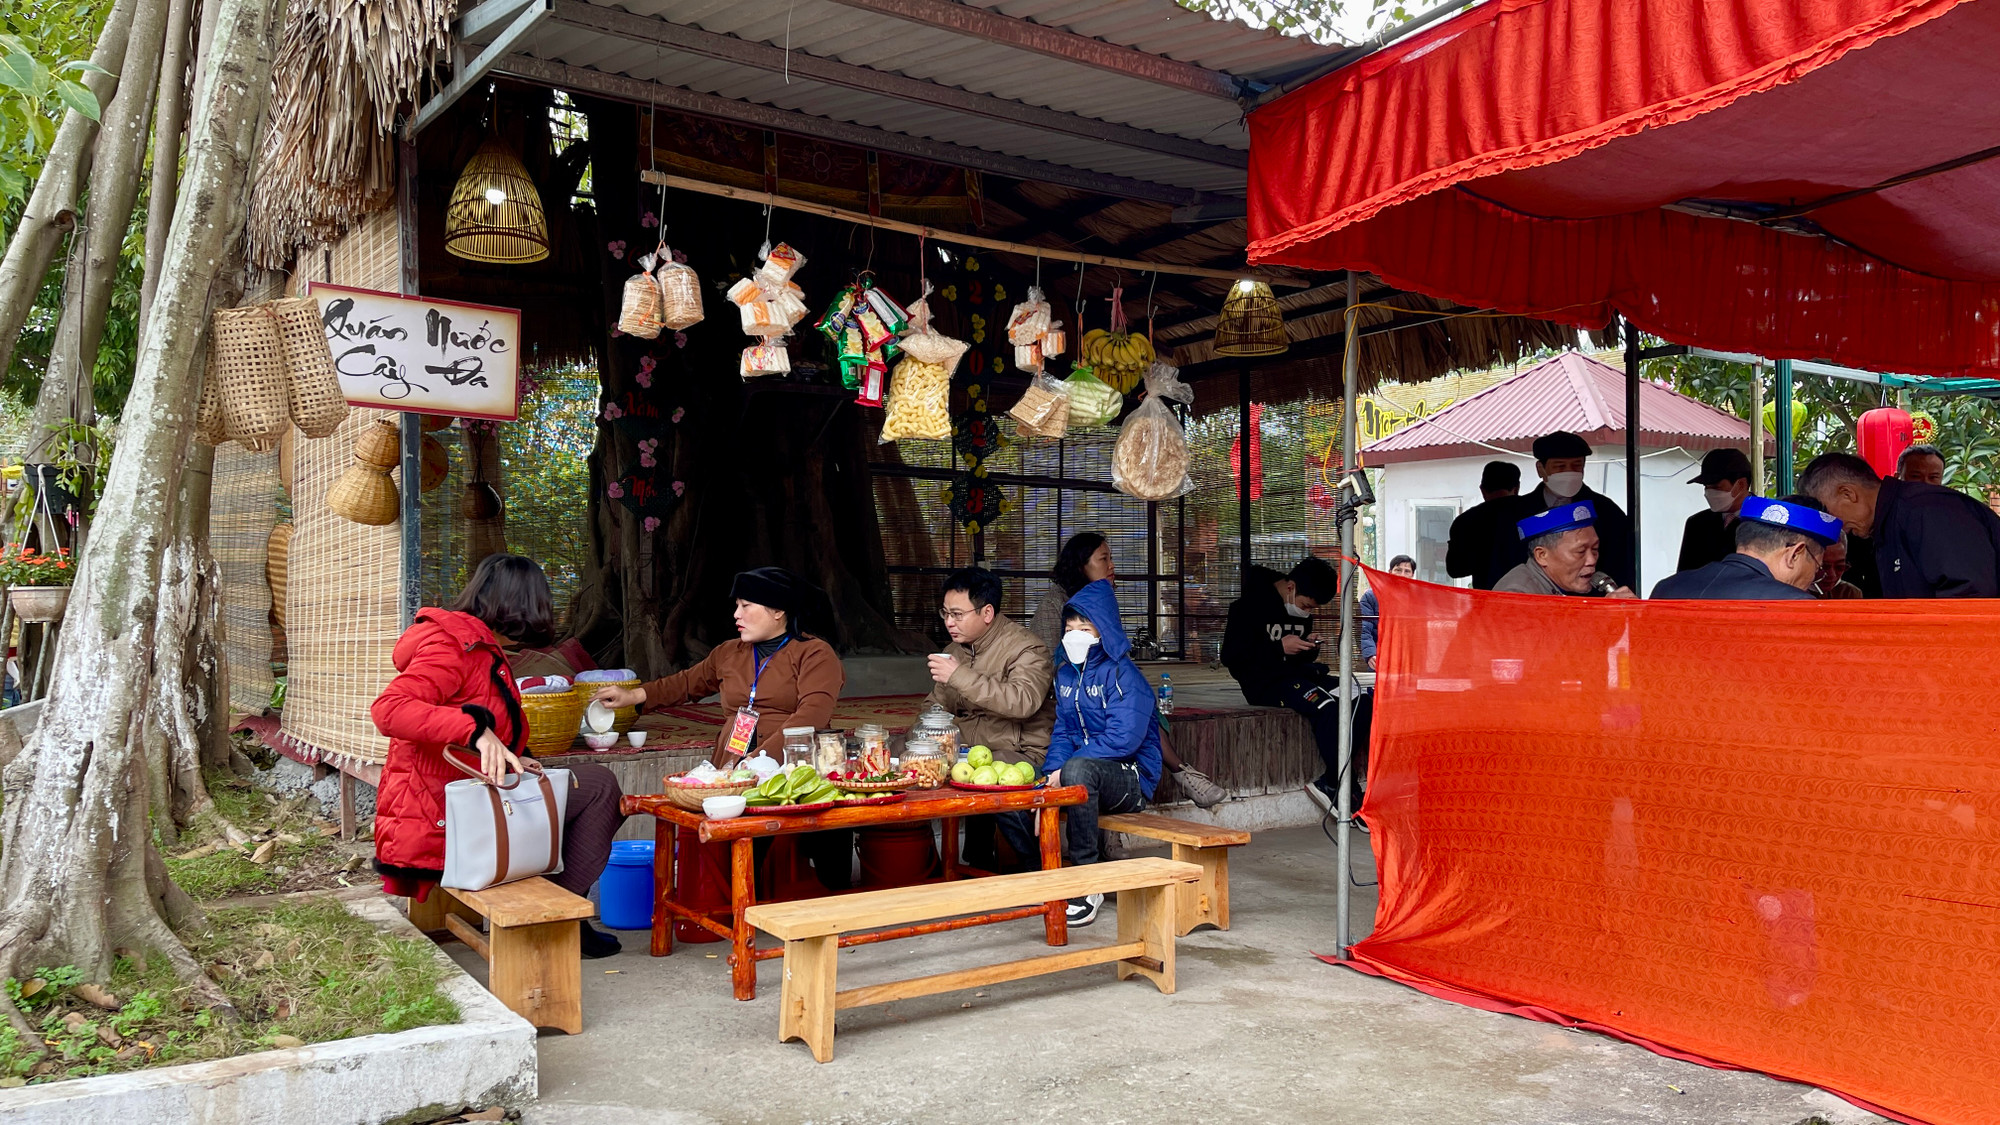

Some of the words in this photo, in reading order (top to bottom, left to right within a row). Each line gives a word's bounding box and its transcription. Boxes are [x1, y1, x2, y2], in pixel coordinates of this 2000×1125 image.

[322, 297, 408, 343] Quán
[425, 308, 511, 360] Nước
[335, 343, 430, 399] Cây
[425, 355, 489, 388] Đa
